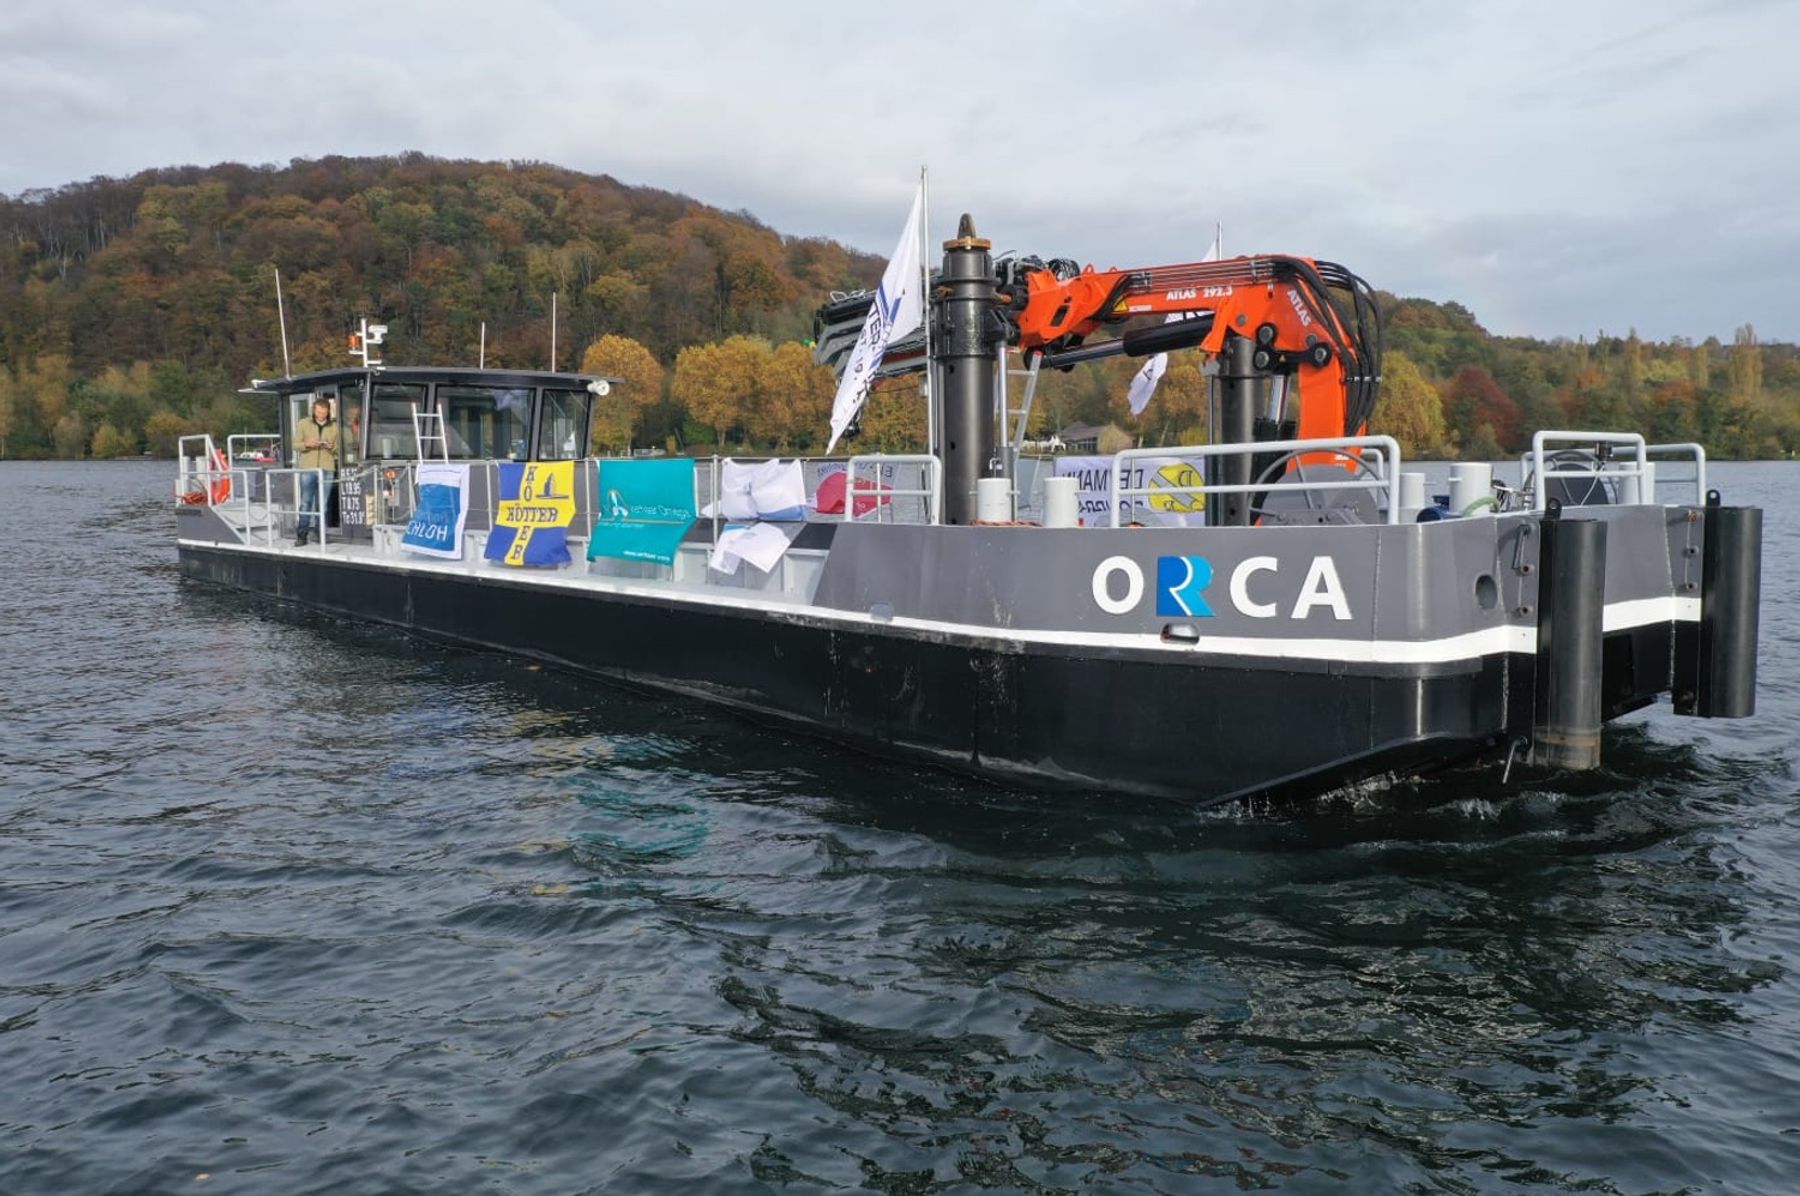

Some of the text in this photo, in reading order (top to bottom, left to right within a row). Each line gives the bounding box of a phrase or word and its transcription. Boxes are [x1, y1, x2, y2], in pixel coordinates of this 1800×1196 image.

[1166, 286, 1233, 301] ATLAS 292.3
[1287, 289, 1312, 327] ATLAS
[506, 503, 559, 523] KÖTTER
[1092, 555, 1353, 620] ORCA
